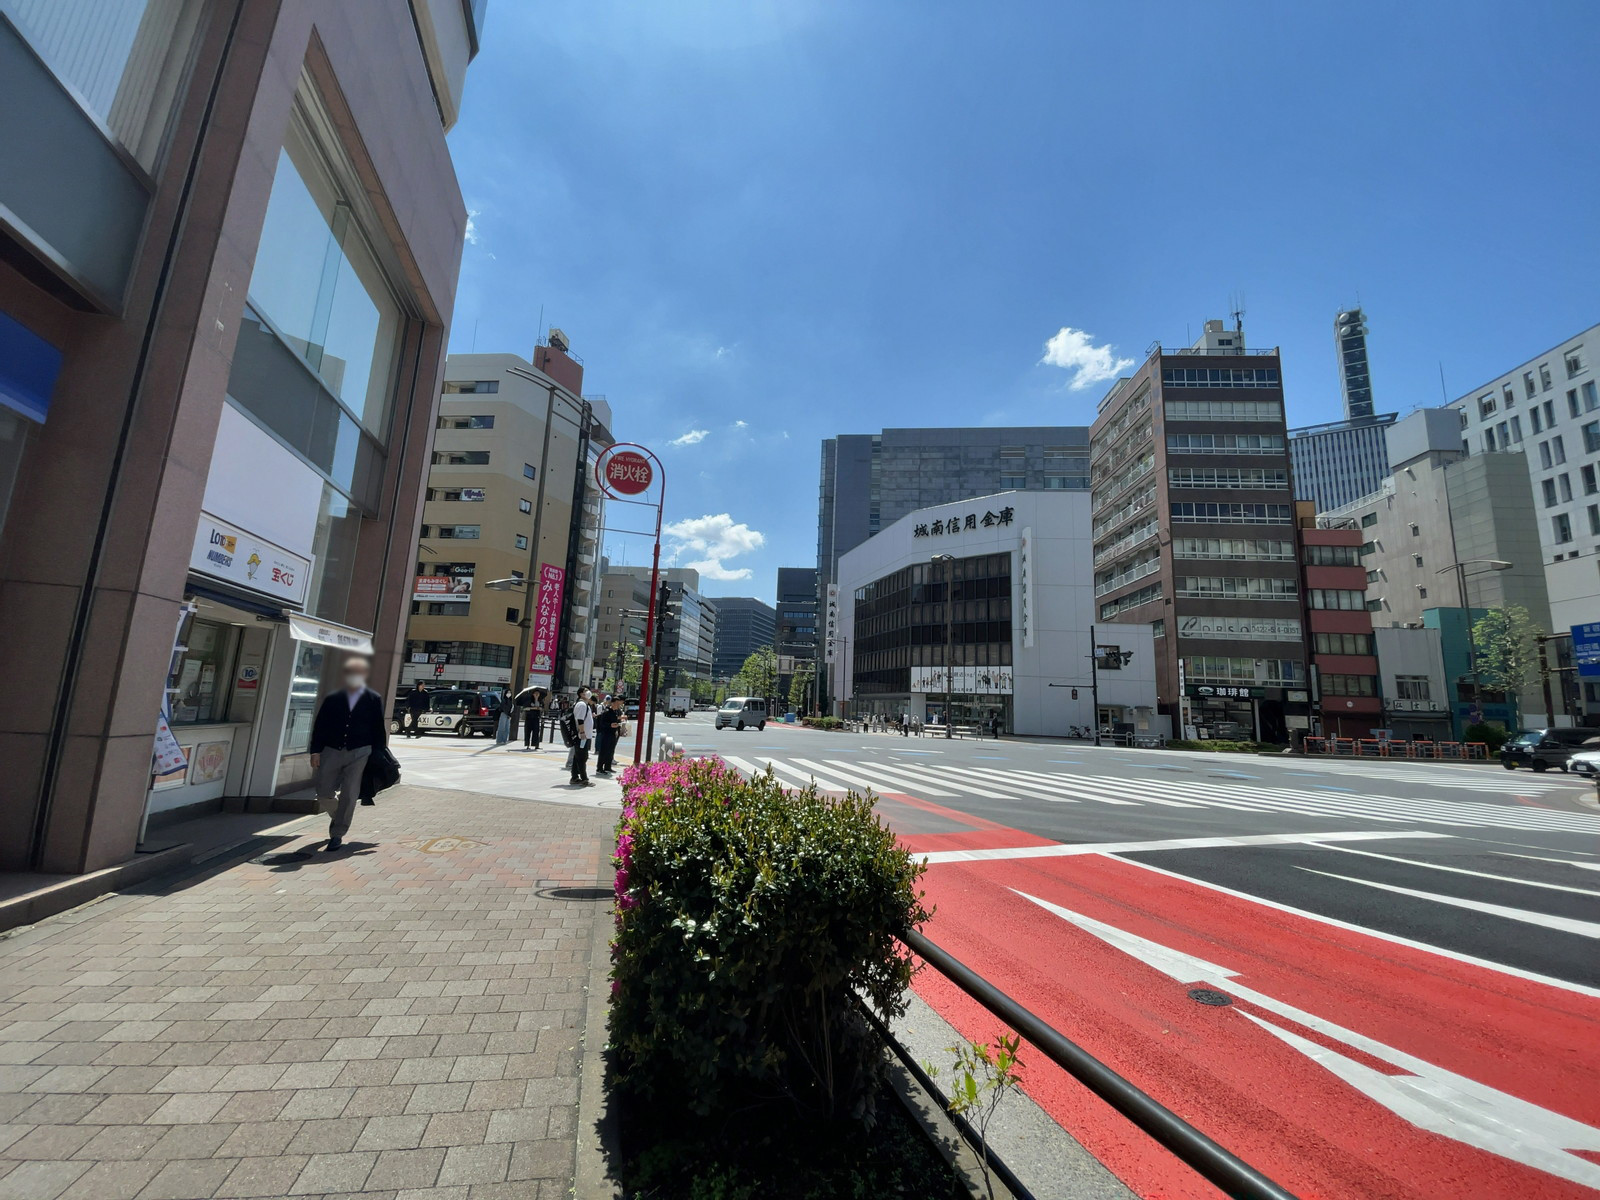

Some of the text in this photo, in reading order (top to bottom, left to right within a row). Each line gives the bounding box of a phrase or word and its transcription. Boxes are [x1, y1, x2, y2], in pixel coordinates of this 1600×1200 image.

[609, 462, 649, 484] 消火栓
[913, 506, 1014, 538] 城南信用金庫
[207, 549, 233, 568] NUMBERS
[272, 567, 295, 587] 宝くじ
[535, 580, 553, 652] みんなの介護
[827, 600, 836, 658] 城南信用金庫
[1216, 687, 1249, 698] 珈琲館
